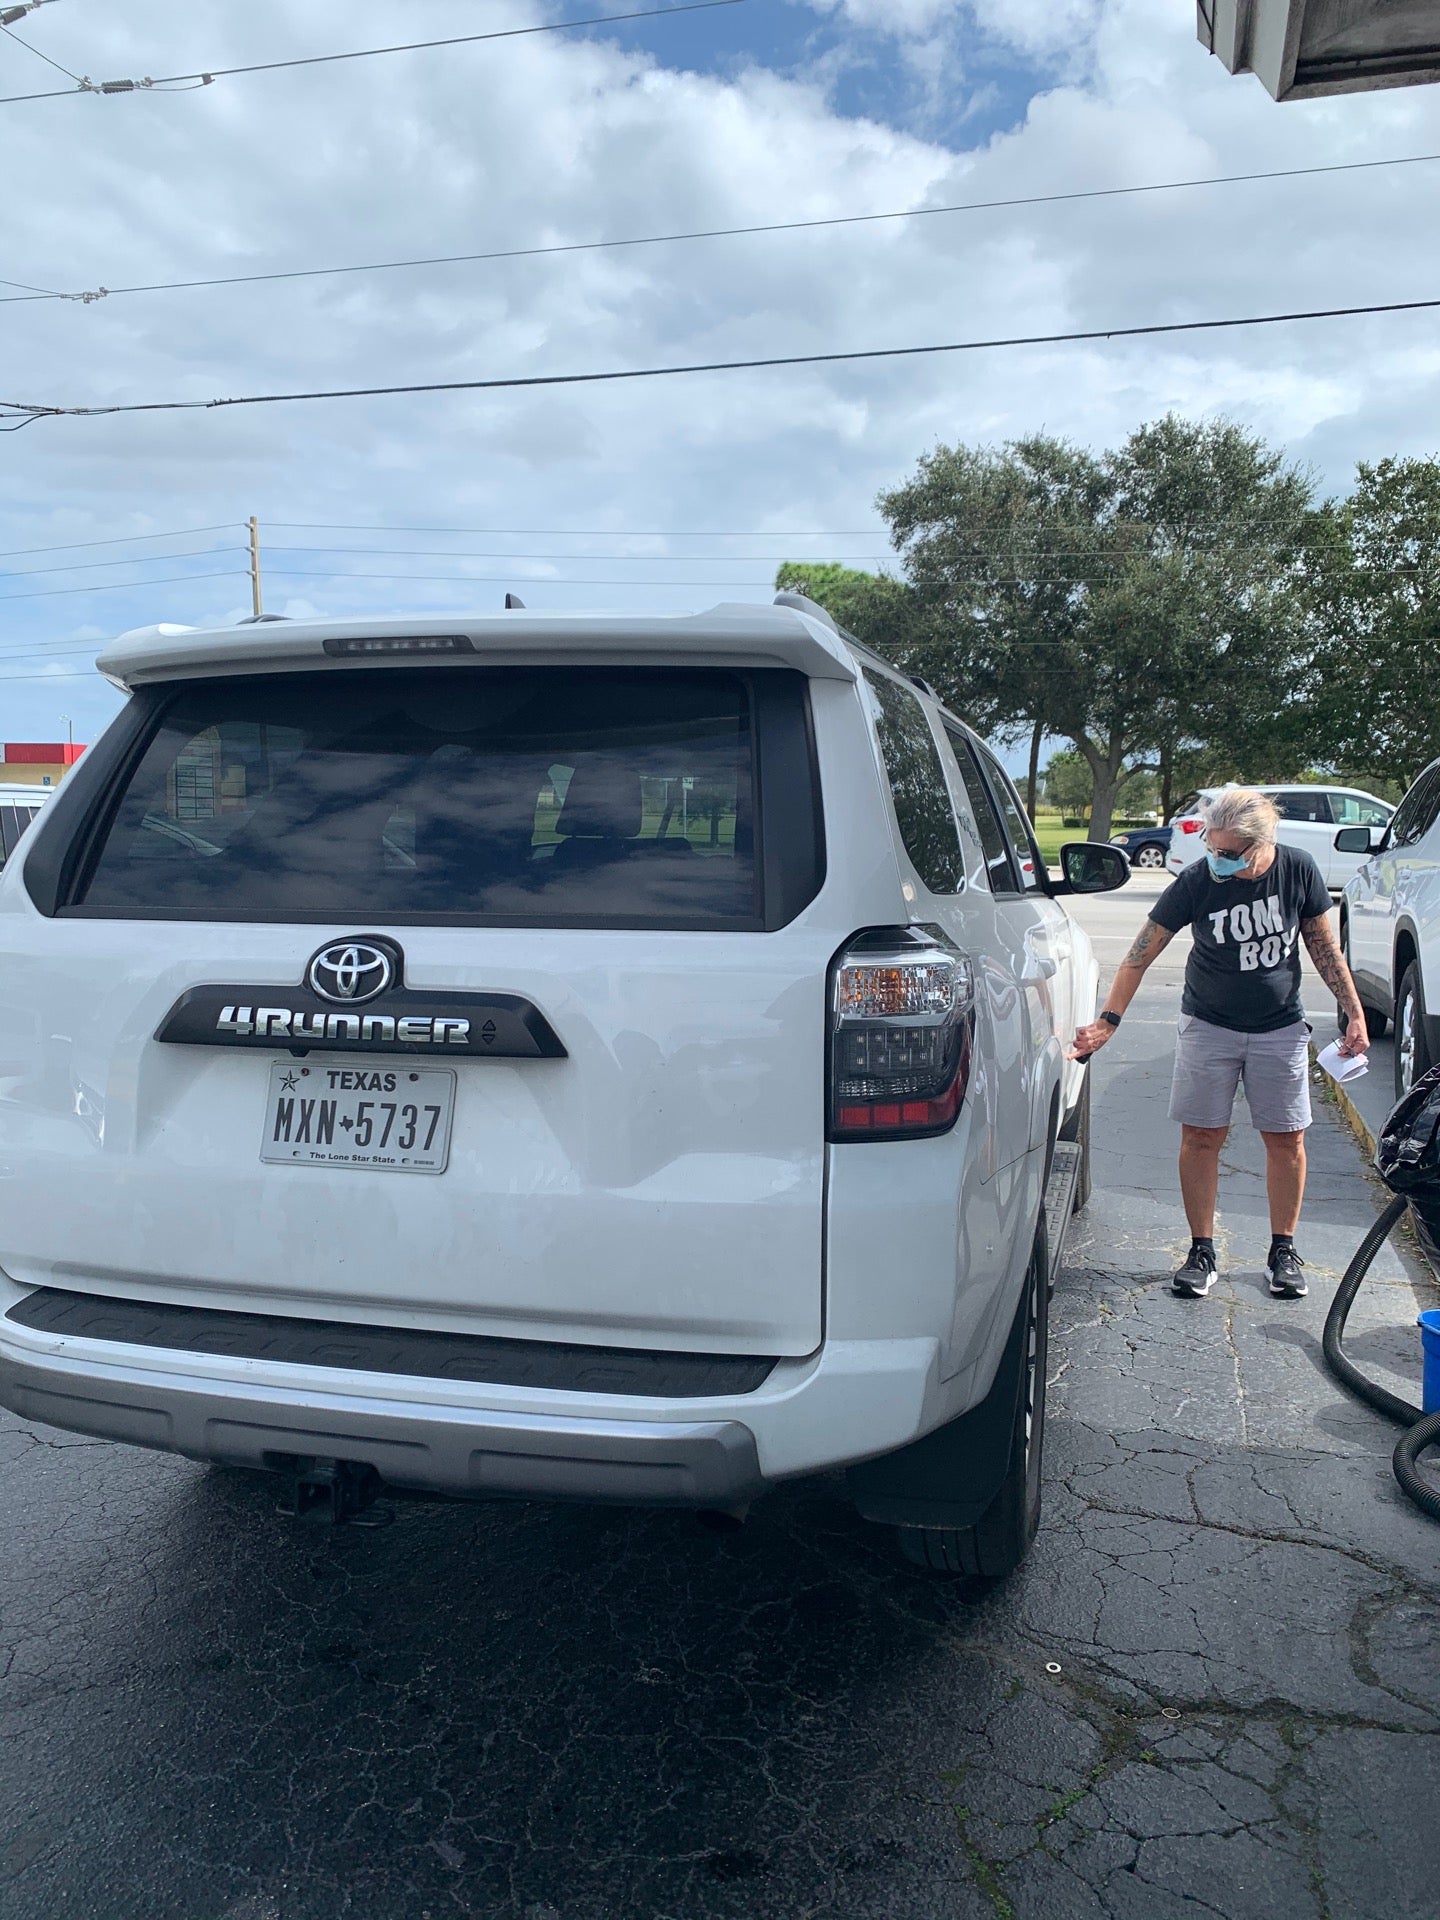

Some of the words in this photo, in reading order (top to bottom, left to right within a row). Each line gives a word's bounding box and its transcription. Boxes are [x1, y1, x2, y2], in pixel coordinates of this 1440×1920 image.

[1208, 894, 1284, 944] TOM
[327, 1070, 396, 1092] TEXAS
[273, 1097, 337, 1145] MXN
[354, 1101, 441, 1151] 5737
[309, 1151, 326, 1160] The
[328, 1153, 350, 1161] Lone
[352, 1154, 370, 1163] Star
[372, 1156, 396, 1165] State
